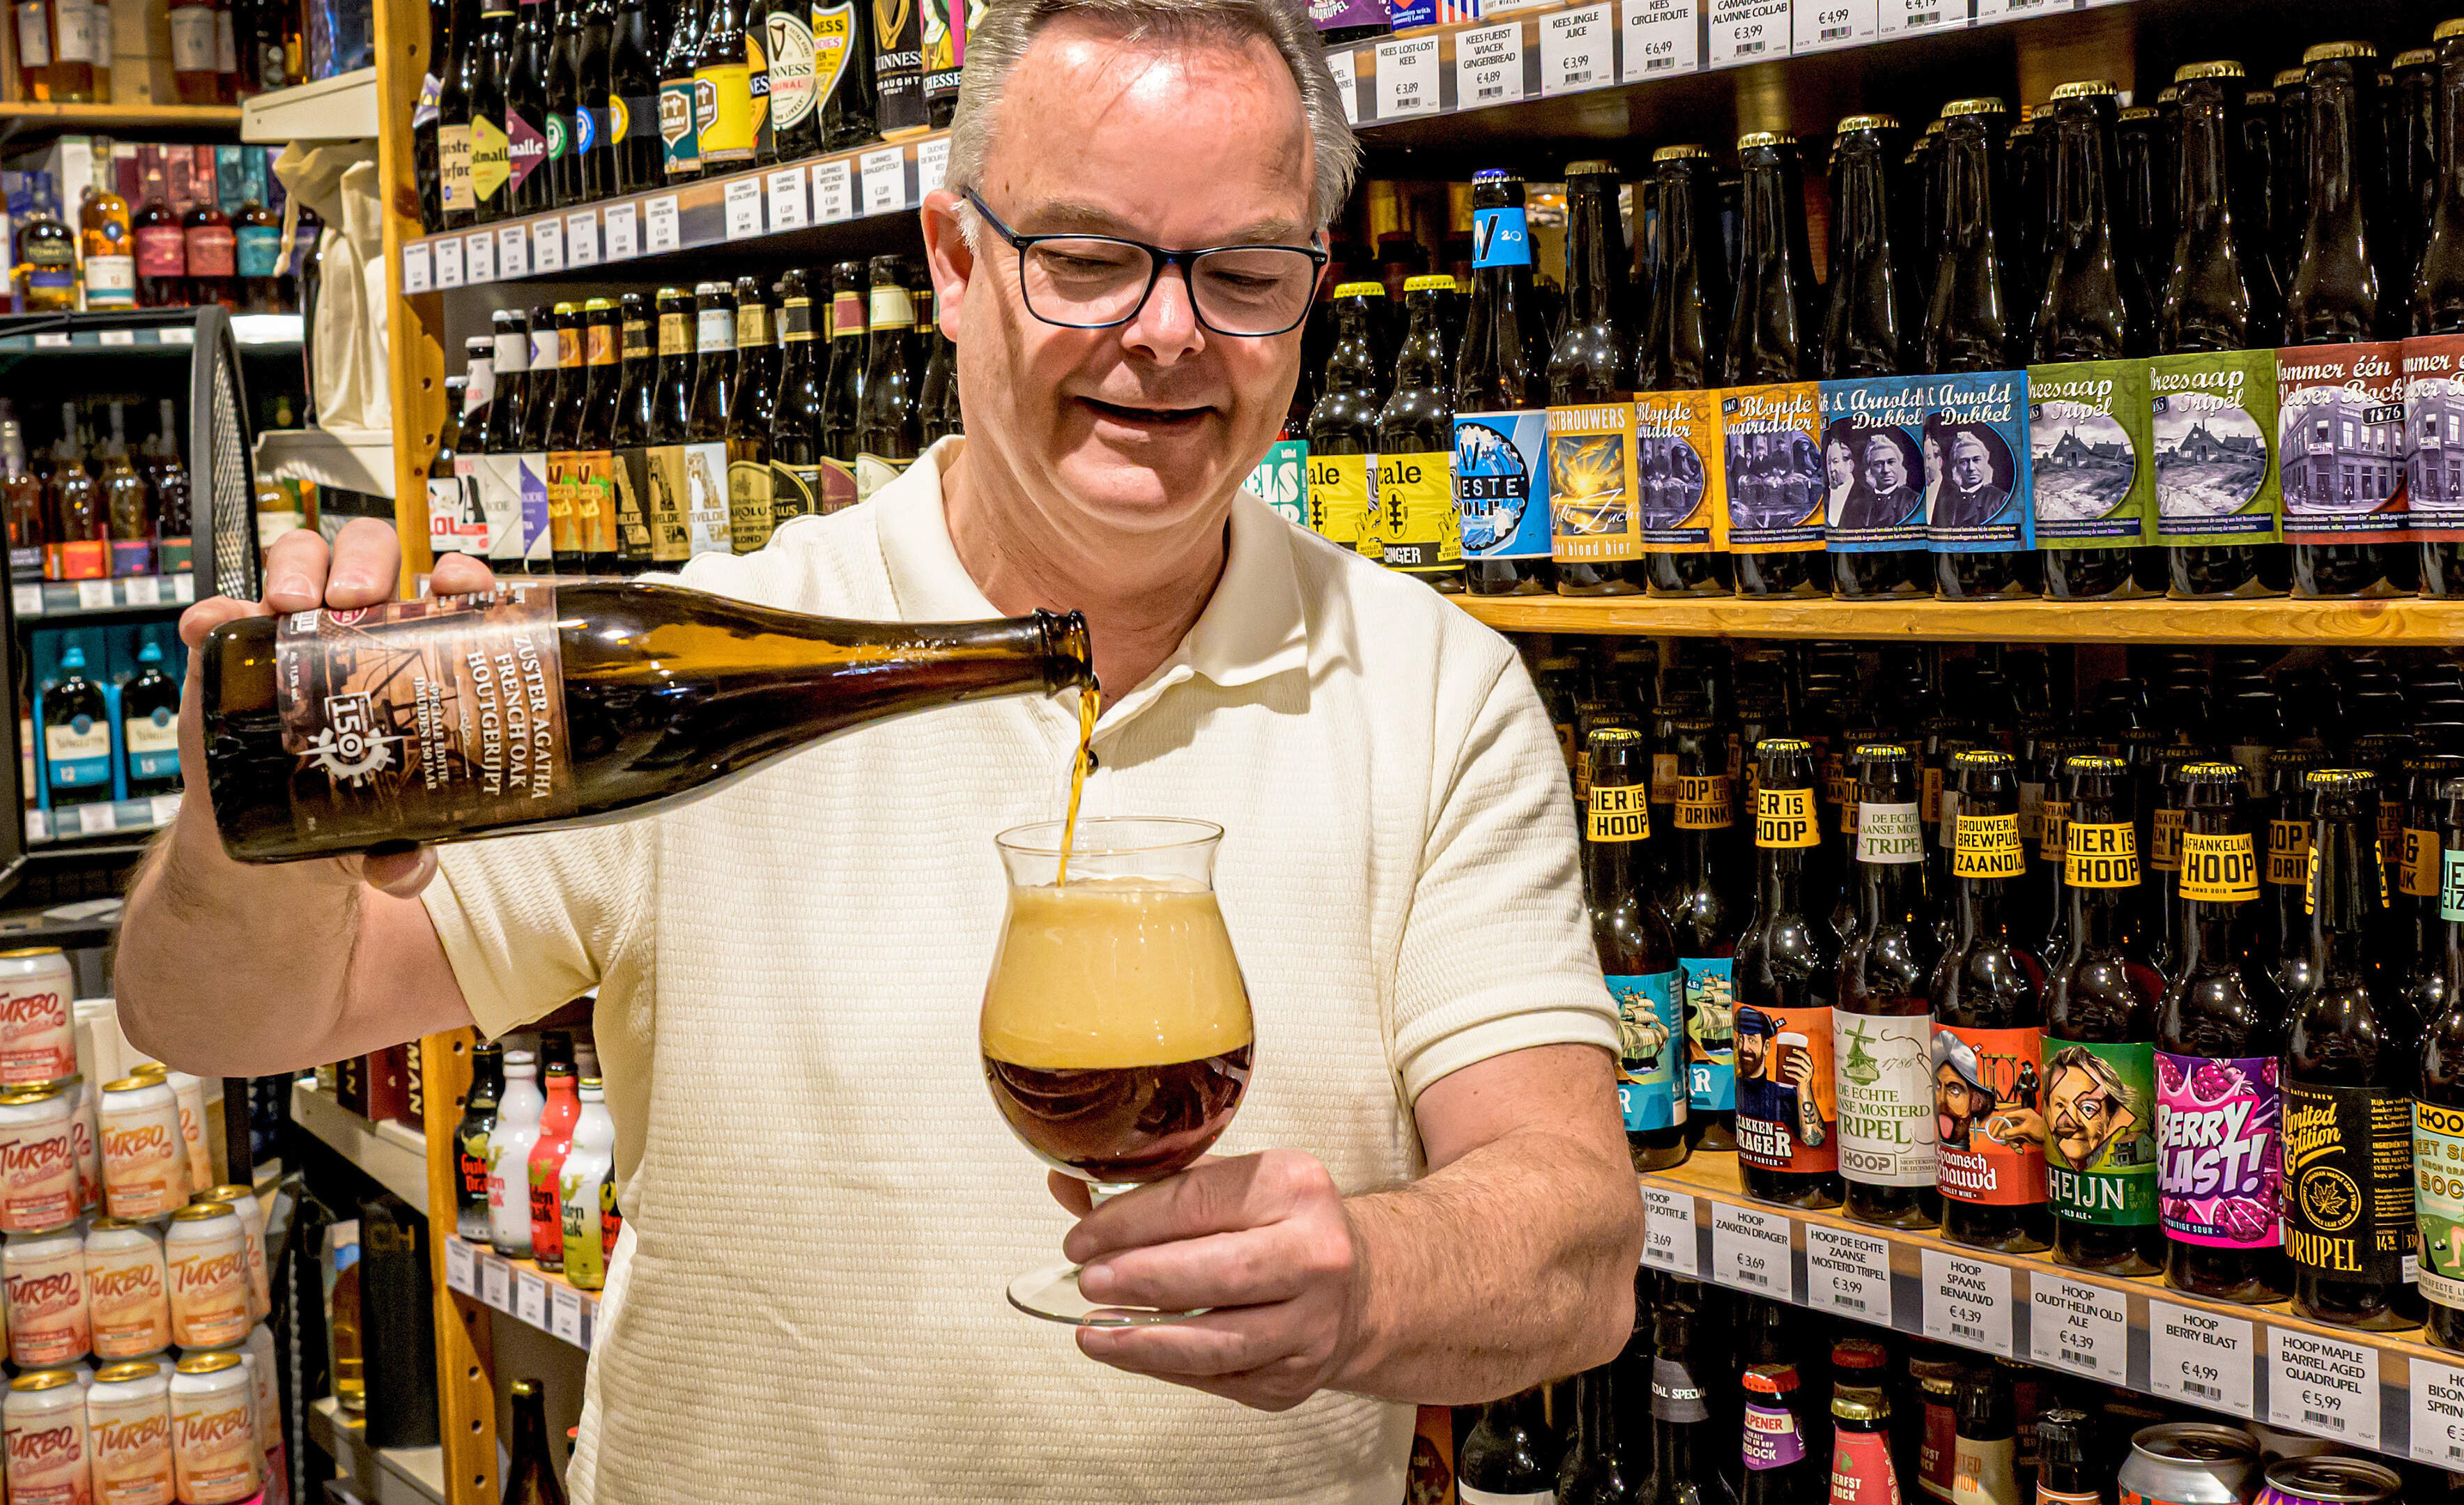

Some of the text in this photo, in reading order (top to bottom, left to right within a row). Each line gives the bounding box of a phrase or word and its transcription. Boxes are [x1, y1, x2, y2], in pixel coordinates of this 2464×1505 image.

[1650, 0, 1670, 10] KEES
[1713, 3, 1787, 24] ALVINNE COLLAB
[1553, 12, 1599, 29] KEES JINGLE
[1632, 8, 1688, 26] CIRCLE ROUTE
[1827, 9, 1849, 22] 4,99
[1466, 29, 1511, 45] KEES FUERST
[1566, 26, 1587, 38] JUICE
[1743, 25, 1762, 38] 3,99
[1380, 41, 1434, 56] KEES LOST-LOST
[1474, 43, 1504, 55] WIACEK
[1653, 40, 1672, 54] 6,49
[1399, 56, 1416, 65] KEES
[1463, 52, 1516, 69] GINGERBREAD
[1571, 55, 1589, 68] 3,99
[1484, 71, 1500, 83] 4,89
[1402, 82, 1418, 93] 3,89
[1501, 230, 1522, 242] 20
[2353, 355, 2392, 378] één
[1851, 387, 1923, 411] Arnold
[1939, 383, 2011, 406] Arnold
[2341, 378, 2403, 405] Bock
[1638, 401, 1692, 423] Blonde
[1740, 394, 1812, 418] Blonde
[2051, 396, 2113, 424] Tripel
[2178, 389, 2245, 417] Tripel
[1852, 409, 1924, 430] Dubbel
[1941, 404, 2012, 426] Dubbel
[2370, 406, 2401, 422] 1876
[1383, 546, 1422, 564] GINGER
[1569, 539, 1631, 556] blond bier
[467, 649, 502, 796] HOUTGERIJPT
[495, 652, 528, 788] FRENCH OAK
[513, 634, 552, 799] ZUSTER AGATHA
[332, 699, 364, 757] 150
[429, 681, 449, 782] SPECIALE EDITIE
[425, 765, 438, 790] JAAR
[1592, 789, 1643, 811] HIER IS
[1786, 797, 1804, 815] IS
[1597, 813, 1647, 836] HOOP
[1872, 815, 1887, 824] DE
[1958, 819, 2017, 832] BROUWERIJ
[1958, 833, 2017, 848] BREWPUB
[2068, 828, 2134, 853] HIER IS
[2077, 857, 2139, 883] HOOP
[2188, 854, 2254, 883] HOOP
[1882, 1057, 1914, 1072] 1786
[1838, 1083, 1900, 1102] DE ECHTE
[2312, 1092, 2333, 1101] BREW
[1858, 1101, 1930, 1118] MOSTERD
[1838, 1111, 1912, 1144] TRIPEL
[2157, 1100, 2256, 1148] BERRY
[2281, 1102, 2337, 1141] Limited
[2284, 1126, 2341, 1176] Edition
[1754, 1155, 1778, 1166] PORTER
[1844, 1150, 1891, 1171] HOOP
[1959, 1189, 1973, 1198] WINE
[2048, 1166, 2125, 1211] HEIJN
[1645, 1191, 1670, 1205] HOOP
[1737, 1212, 1764, 1226] HOOP
[2064, 1210, 2088, 1220] OLD ALE
[1716, 1219, 1788, 1245] ZAKKEN DRAGER
[2192, 1224, 2213, 1235] SOUR
[1653, 1233, 1672, 1247] 3,69
[1811, 1230, 1884, 1254] HOOP DE ECHTE
[2286, 1226, 2362, 1272] DRUPEL
[2376, 1235, 2388, 1251] 14
[1745, 1255, 1765, 1270] 3,69
[1828, 1247, 1867, 1263] ZAANSE
[168, 1252, 242, 1294] TURBO
[1812, 1256, 1886, 1281] MOSTERD TRIPEL
[1950, 1260, 1981, 1276] HOOP
[86, 1263, 153, 1298] TURBO
[1841, 1279, 1862, 1294] 3,99
[1947, 1273, 1986, 1291] SPAANS
[1940, 1286, 1994, 1307] BENAUWD
[2061, 1285, 2095, 1302] HOOP
[1959, 1307, 1982, 1324] 4,39
[2035, 1292, 2067, 1309] OUDT
[2100, 1308, 2123, 1323] OLD
[2068, 1314, 2088, 1329] ALE
[2183, 1314, 2219, 1331] HOOP
[2069, 1332, 2094, 1350] 4,39
[2166, 1324, 2238, 1350] BERRY BLAST
[2283, 1336, 2364, 1364] HOOP MAPLE
[2192, 1363, 2219, 1381] 4,99
[2281, 1350, 2366, 1380] BARREL AGED
[2286, 1367, 2362, 1395] QUADRUPEL
[1672, 1385, 1707, 1400] SPECIAL
[2428, 1384, 2464, 1403] BISON
[2313, 1392, 2341, 1412] 5,99
[2427, 1399, 2464, 1419] SPRIN
[90, 1414, 168, 1458] TURBO
[172, 1405, 249, 1449] TURBO
